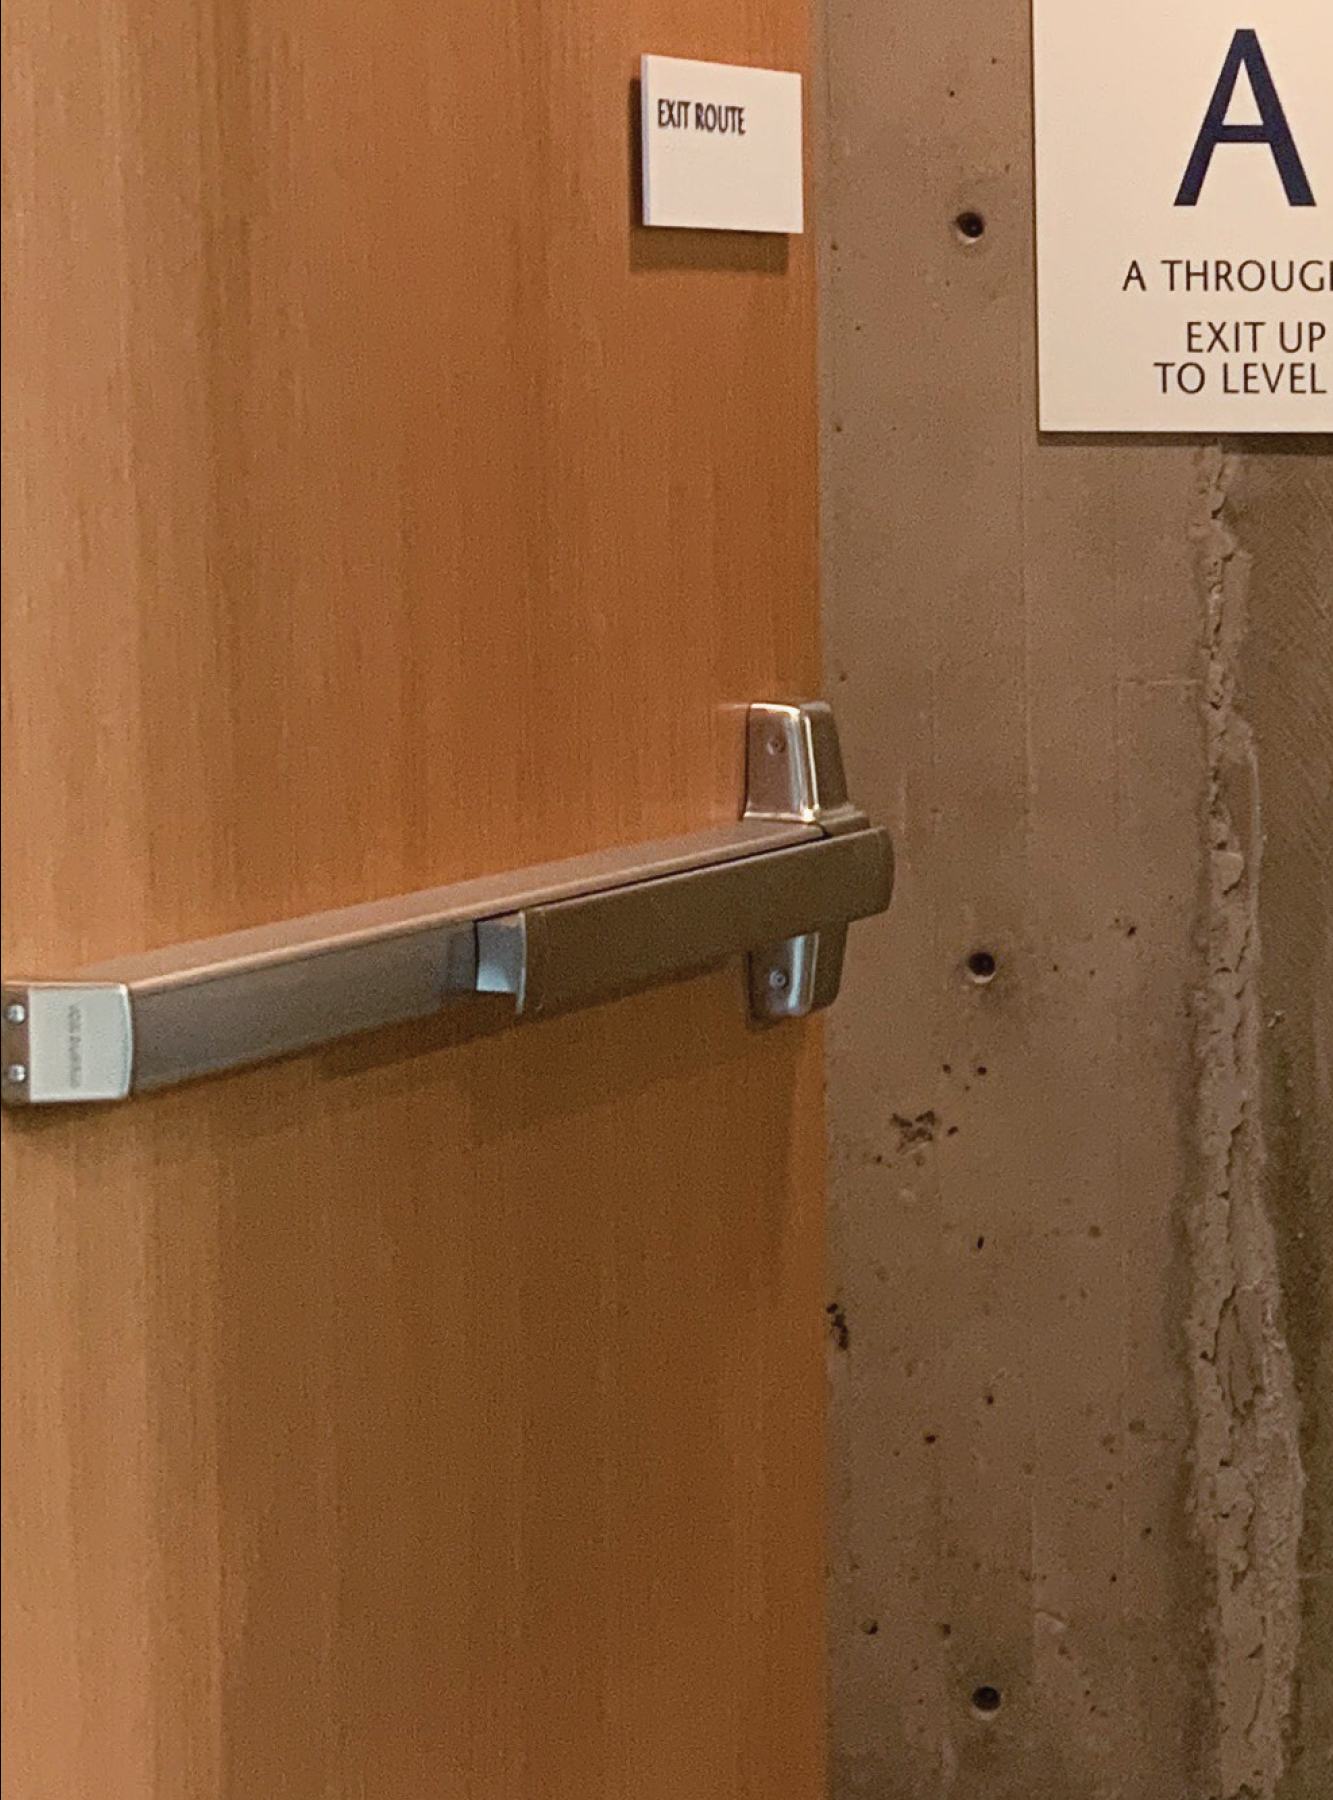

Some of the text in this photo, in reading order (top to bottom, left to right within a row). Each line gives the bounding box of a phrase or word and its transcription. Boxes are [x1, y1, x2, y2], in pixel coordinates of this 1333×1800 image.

[657, 97, 747, 136] EXIT ROUTE
[1172, 28, 1318, 208] A
[1121, 259, 1147, 292] A
[1186, 321, 1327, 354] EXIT UP
[1152, 361, 1206, 395] TO
[1222, 361, 1328, 395] LEVEL
